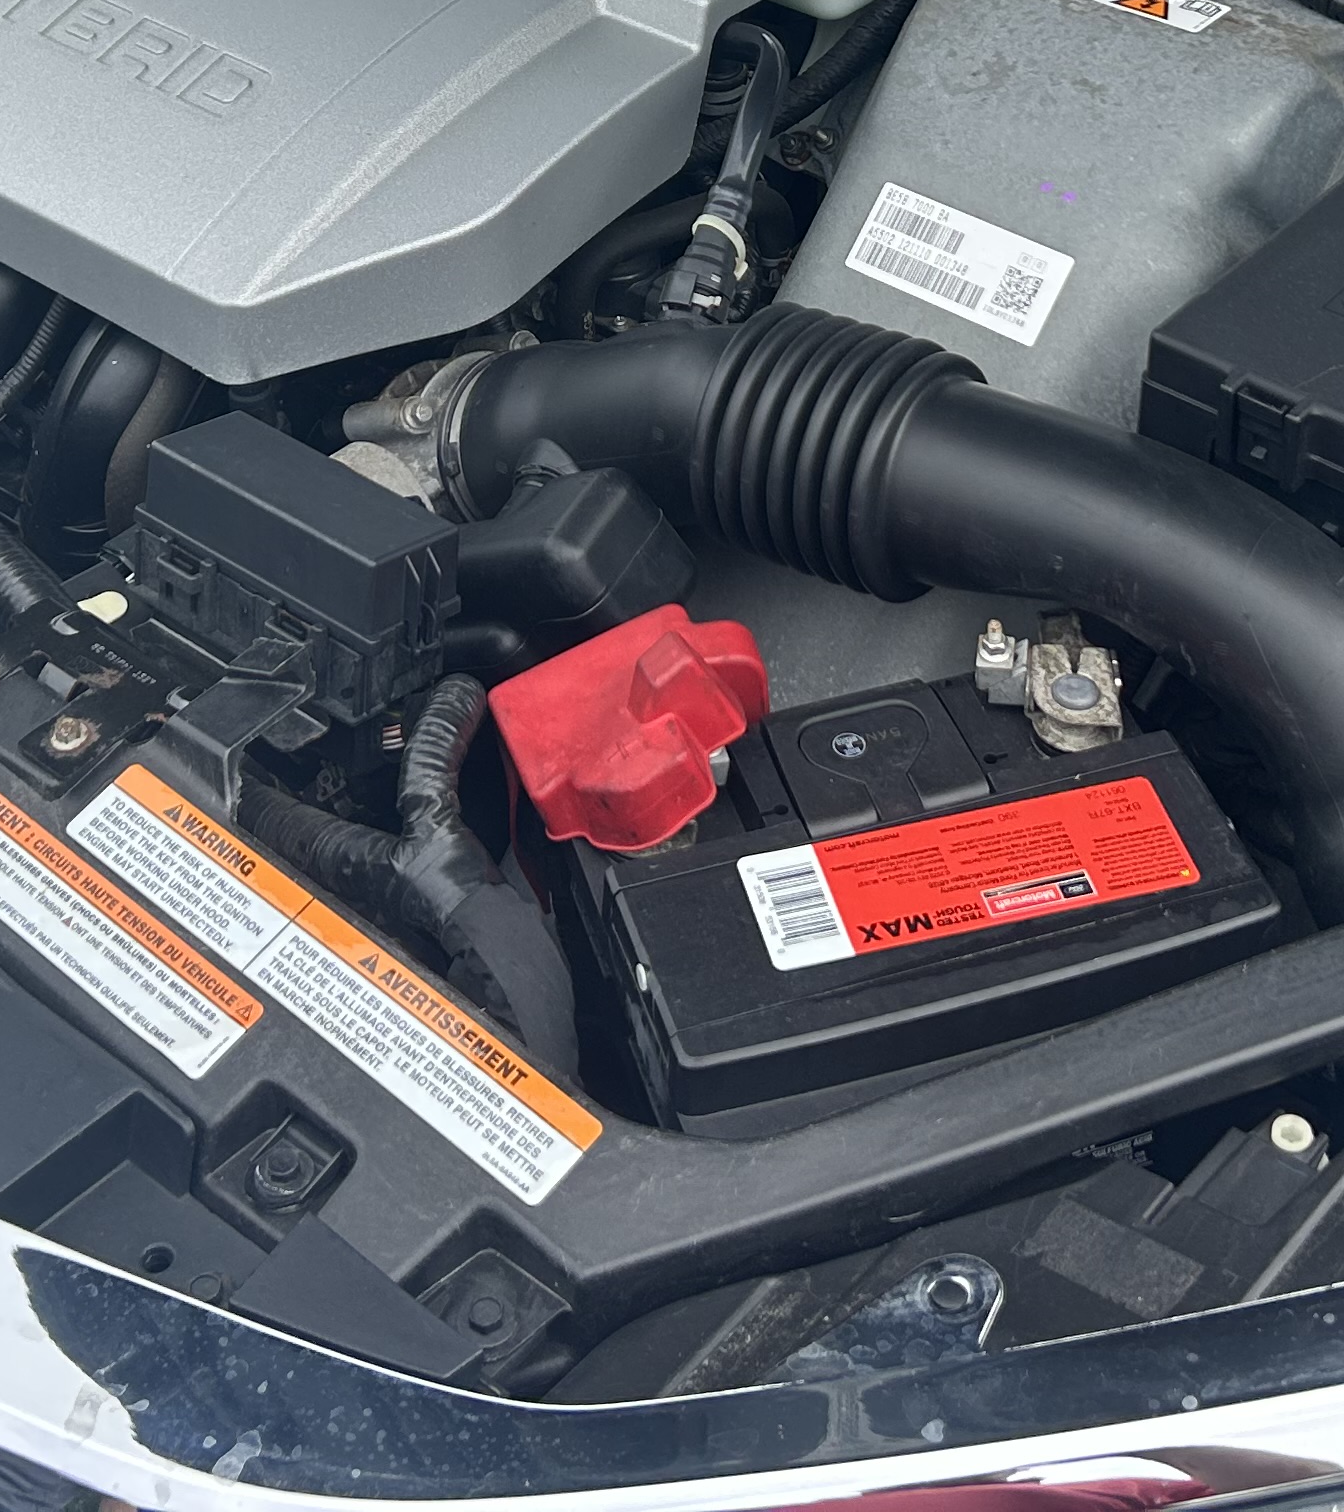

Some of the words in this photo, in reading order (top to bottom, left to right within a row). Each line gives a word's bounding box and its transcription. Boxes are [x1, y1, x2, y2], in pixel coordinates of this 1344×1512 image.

[77, 825, 115, 857] ENGINE
[110, 852, 134, 873] MAY
[129, 867, 162, 895] START
[88, 816, 128, 849] BEFORE
[123, 844, 171, 883] WORKING
[166, 877, 202, 908] UNDER
[98, 806, 140, 840] REMOVE
[136, 835, 158, 854] THE
[154, 849, 177, 869] KEY
[173, 864, 204, 890] FROM
[201, 885, 223, 905] THE
[219, 899, 264, 937] IGNITION
[109, 796, 127, 812] TO
[122, 806, 162, 840] REDUCE
[159, 835, 181, 854] THE
[177, 849, 203, 871] RISK
[199, 866, 217, 882] OF
[178, 812, 259, 878] WARNING
[822, 831, 901, 854] motorcraft.com
[30, 839, 82, 882] CIRCUITS
[78, 877, 118, 910] HAUTE
[115, 906, 166, 949] TENSION
[161, 943, 183, 963] DU
[178, 957, 239, 1007] VÉHICULE
[855, 911, 934, 944] MAX
[934, 909, 985, 928] TESTED
[992, 887, 1057, 911] Motorcraft
[256, 966, 275, 984] EN
[271, 978, 317, 1017] MARCHE
[377, 966, 530, 1089] AVERTISSEMENT
[266, 955, 315, 996] TRAVAUX
[310, 990, 343, 1019] SOUS
[338, 1013, 357, 1030] LE
[391, 1055, 411, 1074] LE
[406, 1067, 455, 1109] MOTEUR
[450, 1103, 483, 1132] PEUT
[480, 1126, 500, 1146] SE
[496, 1139, 545, 1182] METTRE
[277, 944, 296, 962] LA
[290, 955, 316, 977] CLÉ
[311, 971, 330, 989] DE
[388, 1033, 425, 1065] AVANT
[515, 1134, 543, 1160] DES
[287, 933, 320, 962] POUR
[315, 956, 363, 996] RÉDUIRE
[358, 989, 383, 1012] LES
[378, 1006, 428, 1048] RISQUES
[423, 1041, 443, 1060] DE
[503, 1105, 556, 1150] RETIRER
